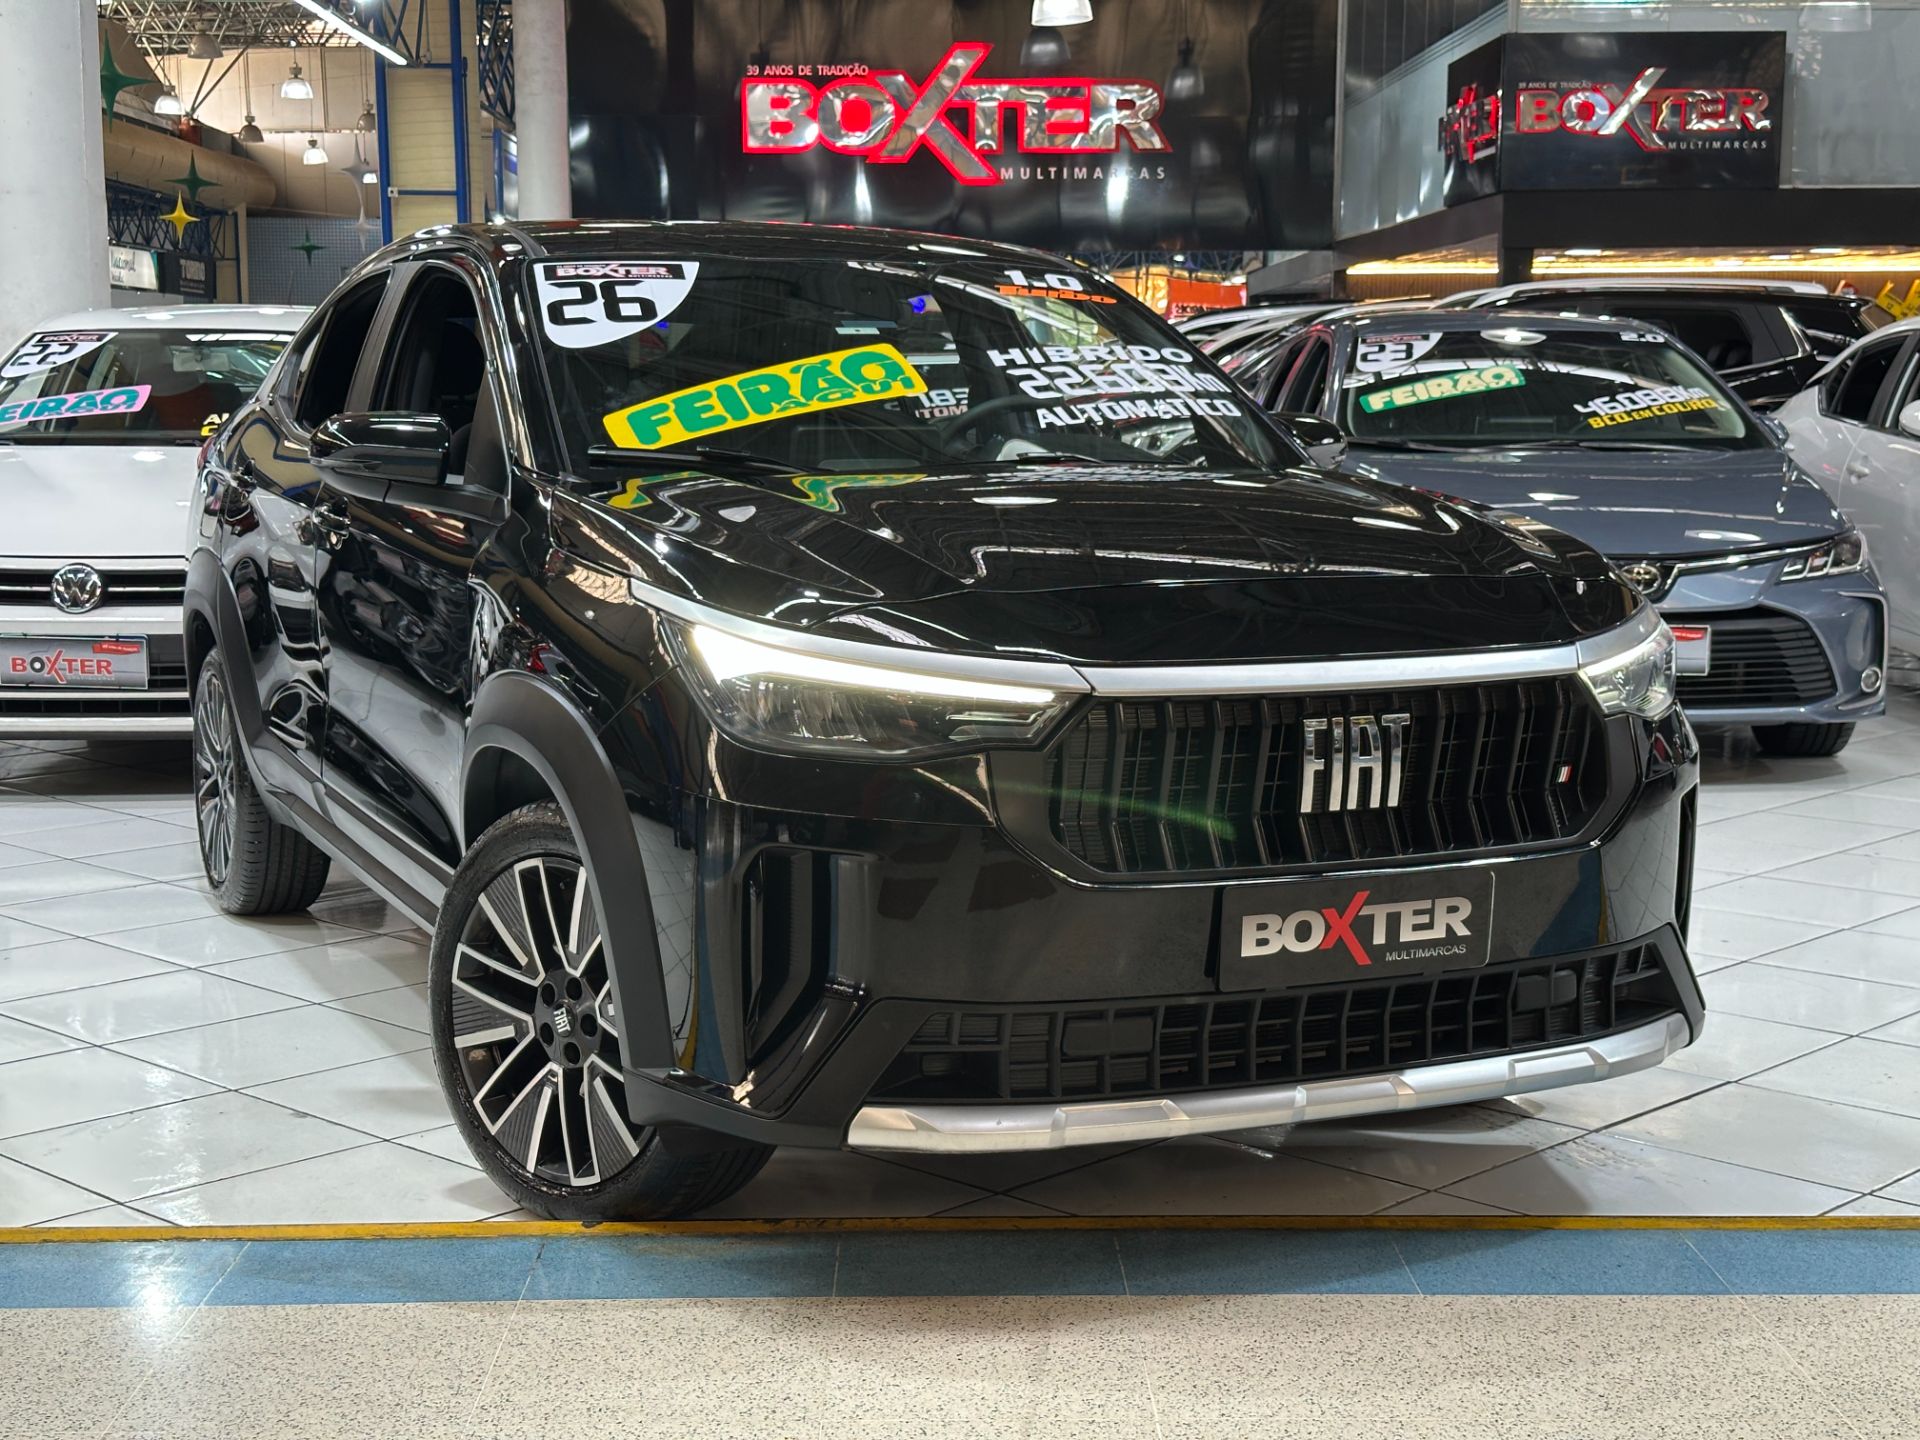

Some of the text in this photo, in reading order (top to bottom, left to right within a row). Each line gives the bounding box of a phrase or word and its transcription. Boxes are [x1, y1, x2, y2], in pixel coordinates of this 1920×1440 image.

[746, 62, 869, 79] 39 ANOS DE TRADIÇÃO
[741, 41, 1172, 187] BOXTER
[1516, 66, 1771, 152] BOXTER
[1668, 140, 1767, 150] MULTIMARCAS
[1000, 166, 1166, 180] MULTIMARCAS
[556, 264, 669, 278] BOXTER
[1003, 270, 1084, 292] 1.0
[547, 280, 658, 326] 26
[1619, 331, 1666, 343] 2.0
[9, 343, 79, 367] 22
[1360, 342, 1414, 362] 23
[627, 351, 905, 445] FEIRÃO
[1368, 365, 1516, 410] FEIRÃO
[0, 388, 140, 423] EIRÃO
[1651, 399, 1718, 417] COURO
[10, 648, 114, 684] BOXTER
[1300, 713, 1411, 813] FIAT
[1241, 890, 1472, 966] BOXTER
[1385, 944, 1467, 962] MULTIMARCAS
[553, 1007, 571, 1033] FIAT
